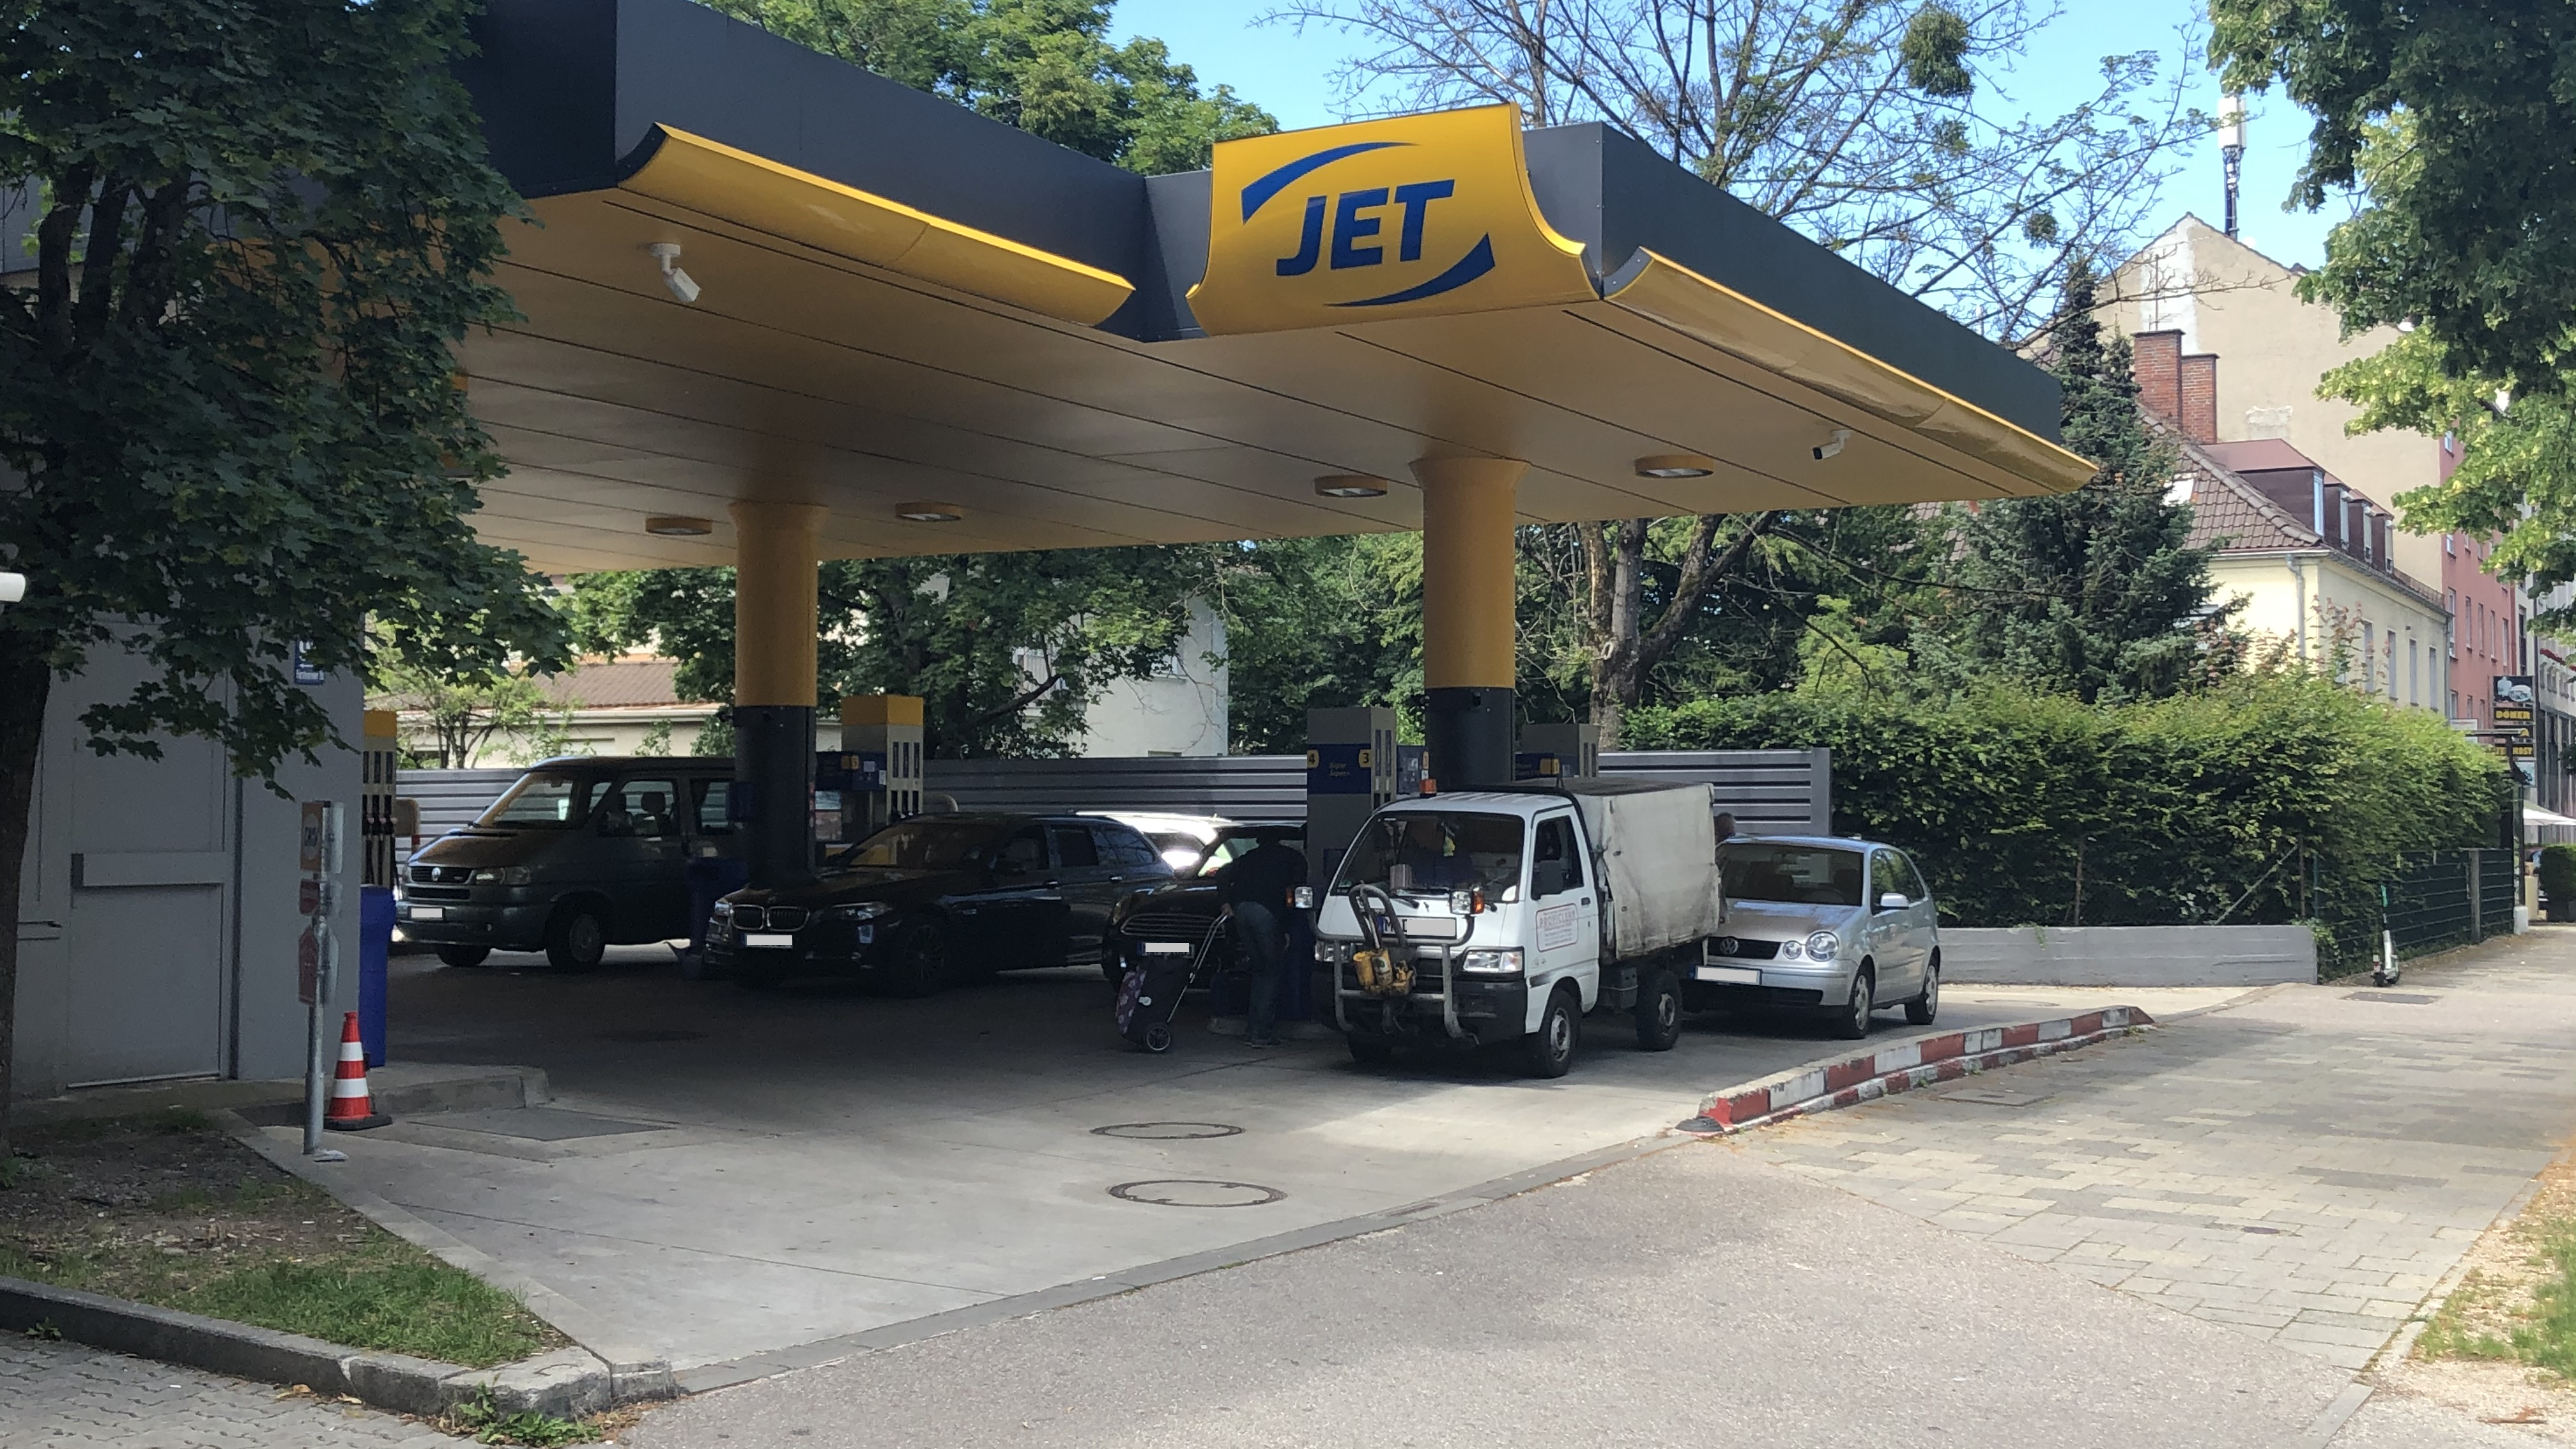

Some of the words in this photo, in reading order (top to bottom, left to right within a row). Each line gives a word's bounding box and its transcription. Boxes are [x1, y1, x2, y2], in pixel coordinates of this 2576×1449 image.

[1276, 180, 1454, 276] JET
[1308, 754, 1315, 765] 4
[1363, 753, 1370, 764] 3
